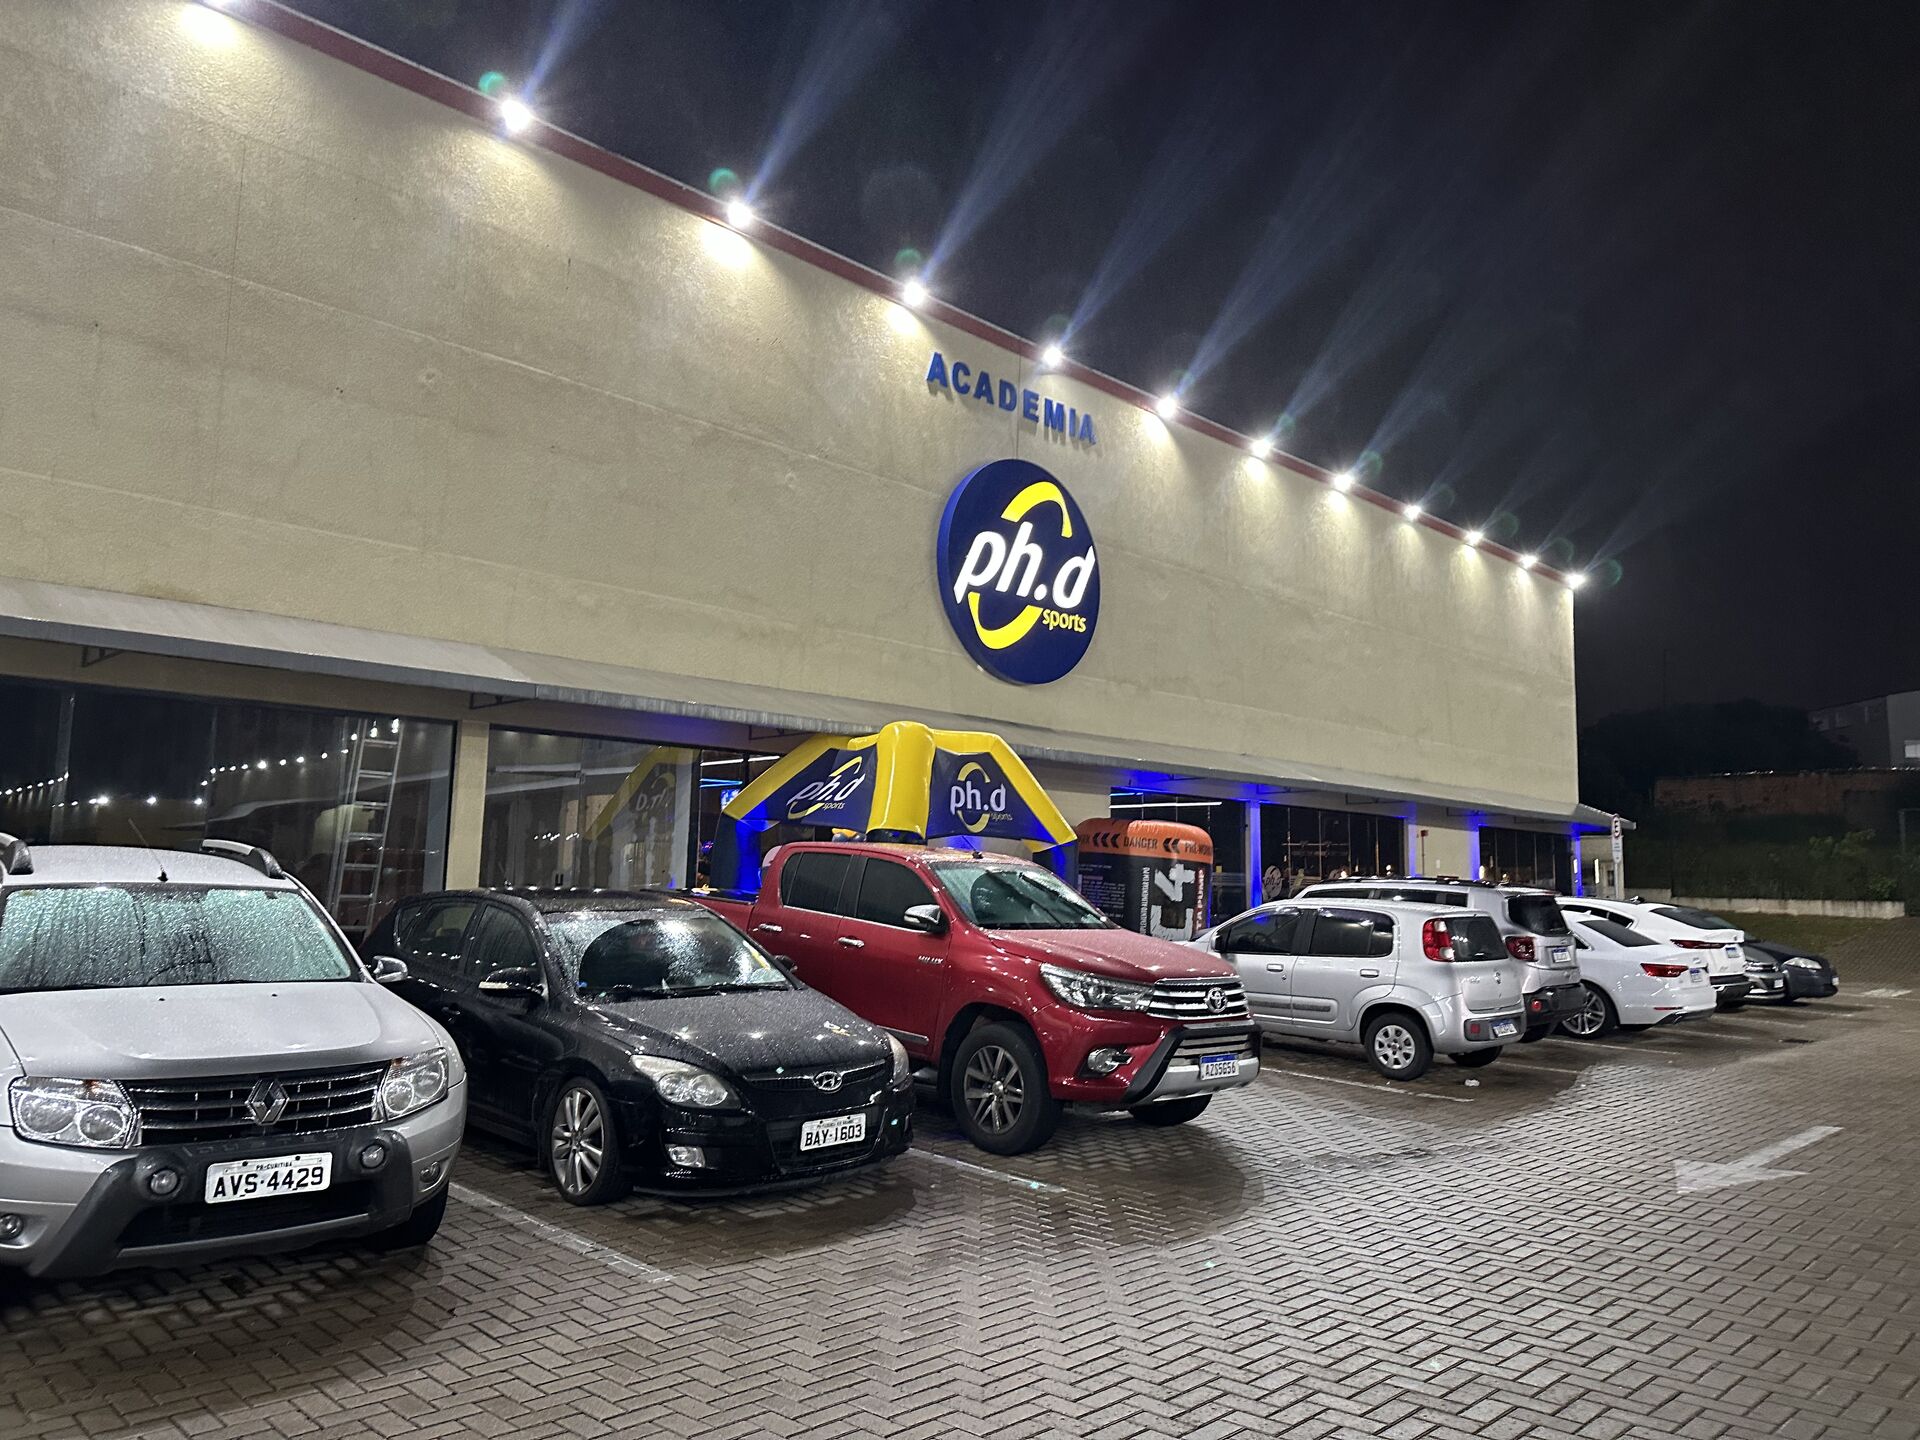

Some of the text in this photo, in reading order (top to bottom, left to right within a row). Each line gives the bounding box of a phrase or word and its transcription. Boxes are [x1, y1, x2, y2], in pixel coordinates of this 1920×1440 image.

[926, 352, 1097, 445] ACADEMIA
[953, 521, 1096, 609] ph.d
[1042, 609, 1087, 633] sports
[786, 773, 867, 806] ph.d
[822, 801, 846, 811] sports
[950, 780, 1006, 815] ph.d
[989, 812, 1013, 822] sports
[1123, 836, 1158, 850] DANGER
[1150, 863, 1196, 941] C4
[1197, 869, 1205, 908] PUMP
